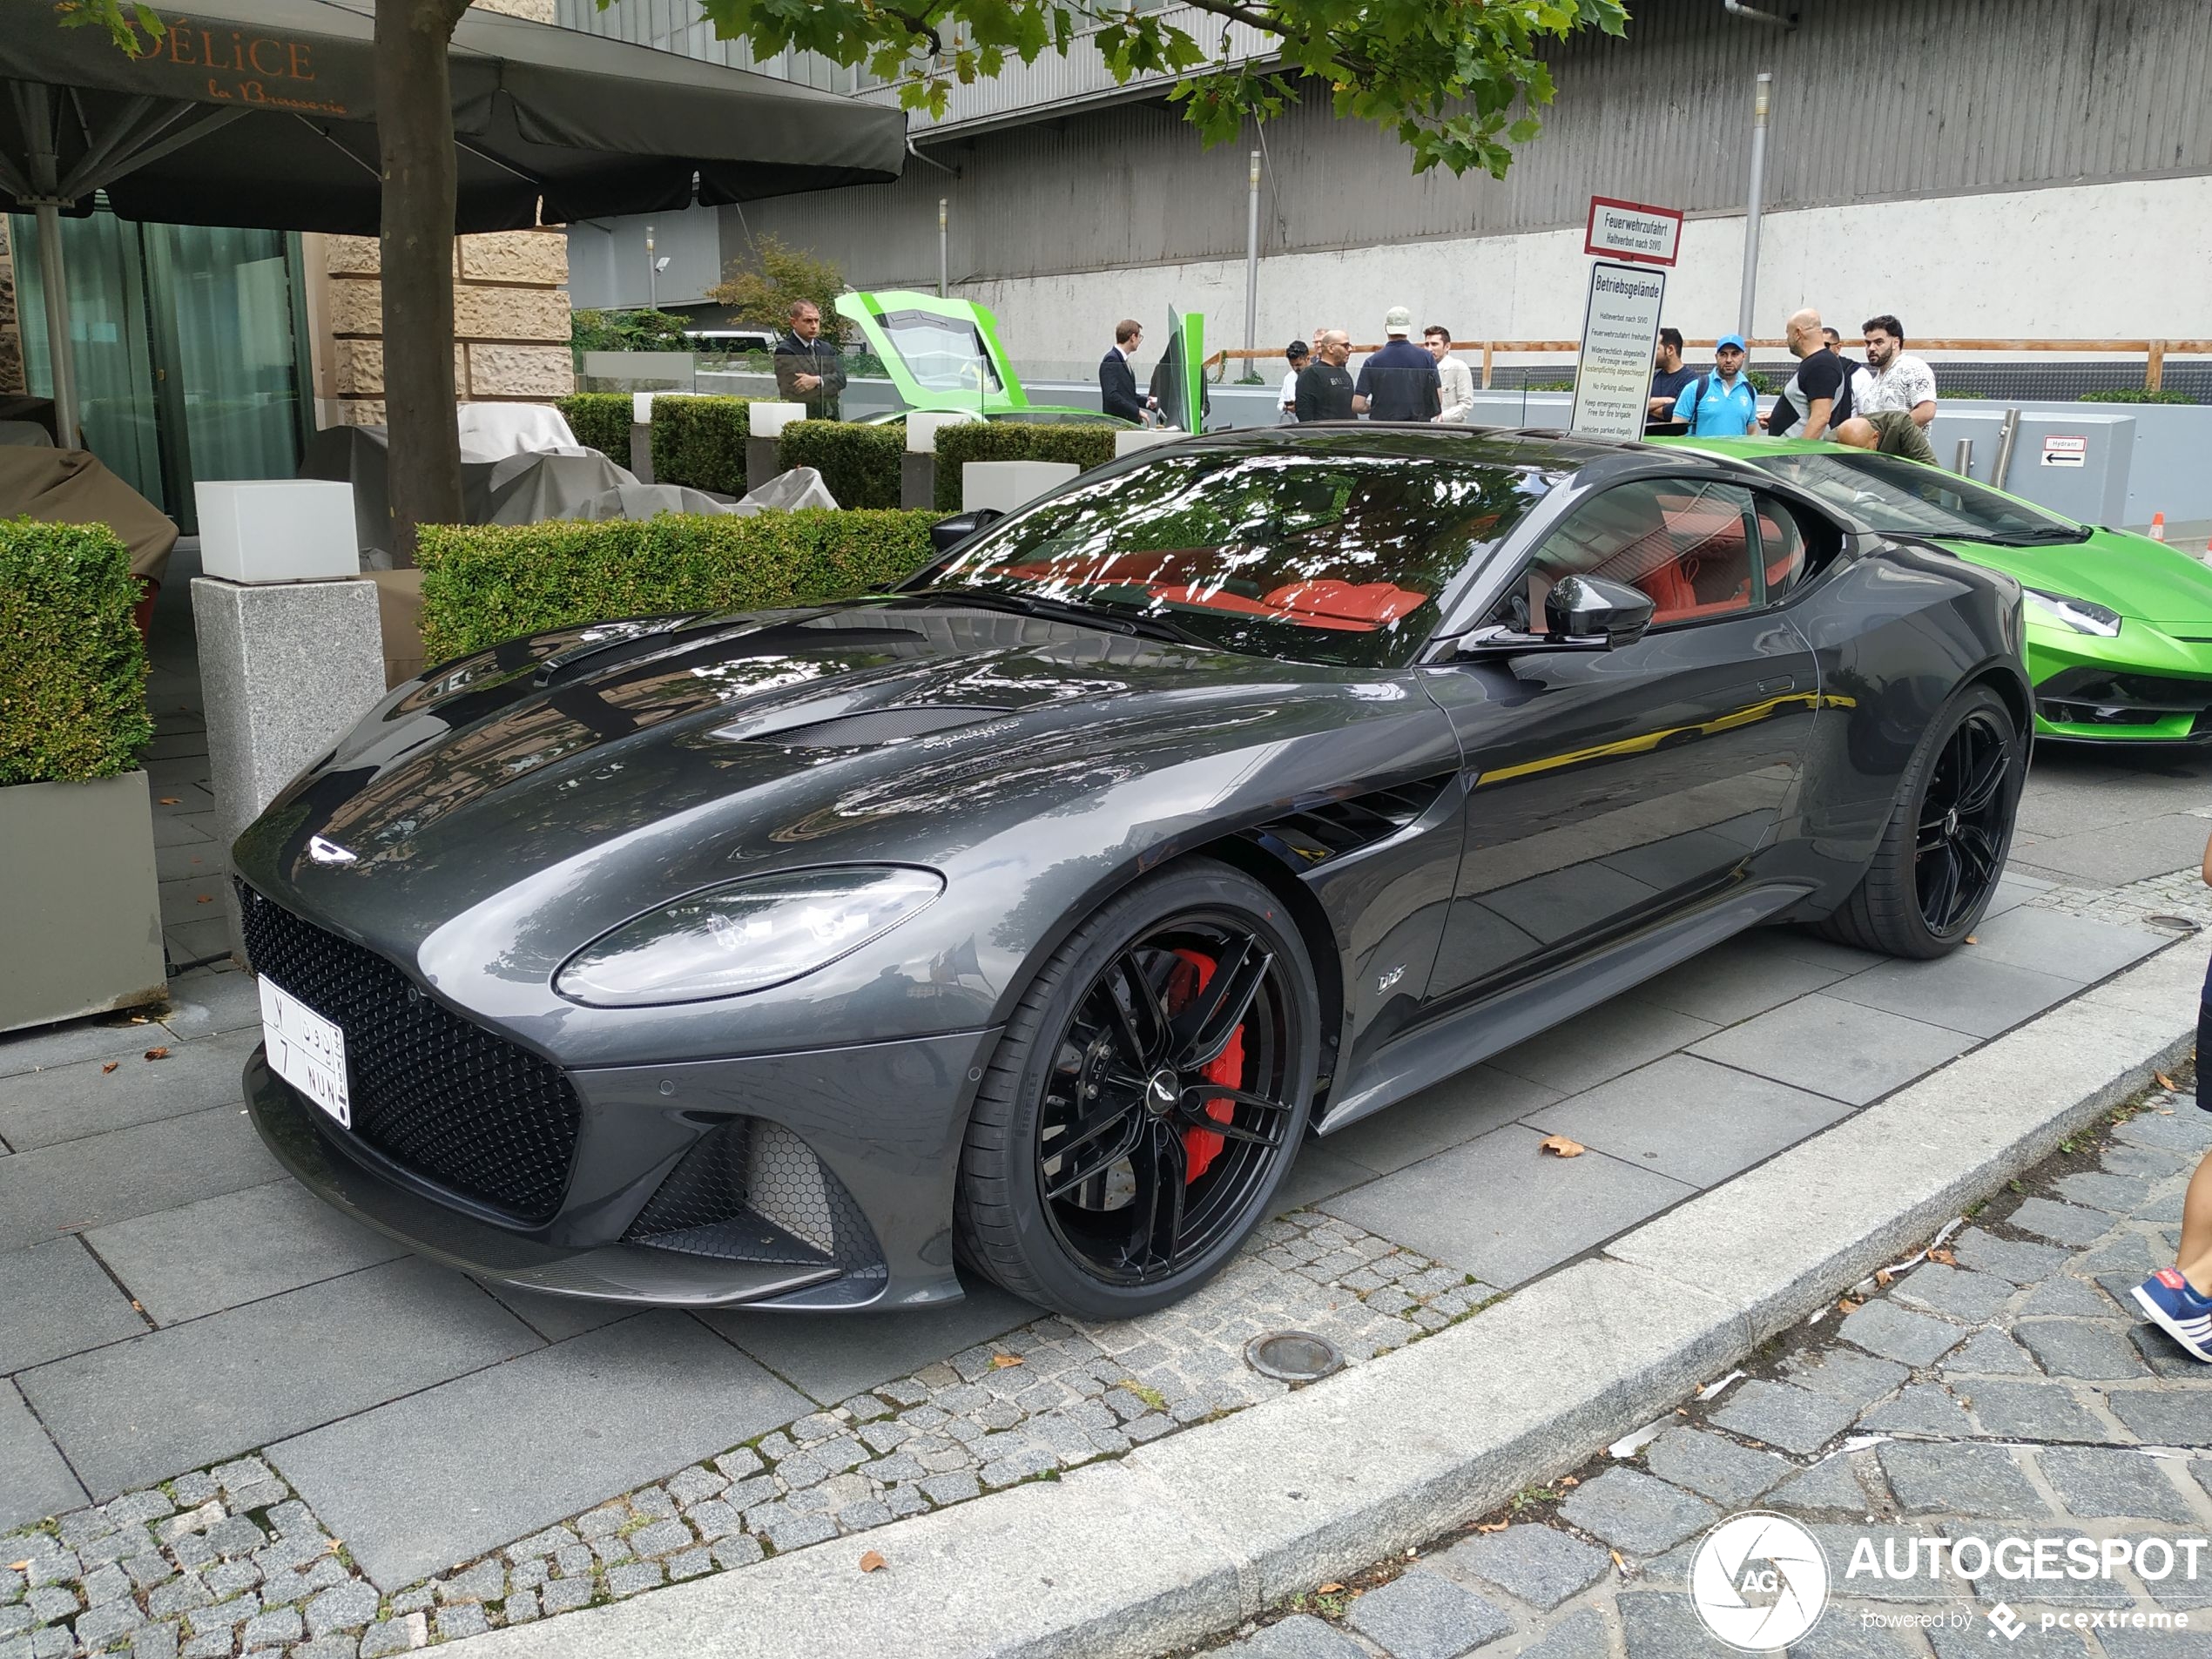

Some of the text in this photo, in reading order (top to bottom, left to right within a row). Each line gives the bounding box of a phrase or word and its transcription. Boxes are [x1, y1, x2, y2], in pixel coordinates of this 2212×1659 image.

[208, 78, 347, 113] la Brasserie
[1604, 212, 1668, 236] Feuerwehrzufahrt
[1606, 233, 1662, 251] Haltverbot nach StVO
[1595, 274, 1659, 299] Betriebsgelände
[1590, 327, 1652, 342] Feuerwehrzufahrt freihalten
[1591, 346, 1647, 359] Widerrechtlich abgestellte
[1597, 355, 1620, 366] Fahrzeuge
[1584, 365, 1616, 376] kostenpflichtig
[1600, 382, 1617, 393] Parking
[1617, 384, 1635, 393] allowed
[1584, 399, 1596, 408] Keep
[1596, 401, 1621, 410] emergency
[1615, 410, 1631, 419] brigade
[1581, 425, 1633, 436] Vehicles parked illegally
[280, 1038, 336, 1106] 7 NUN
